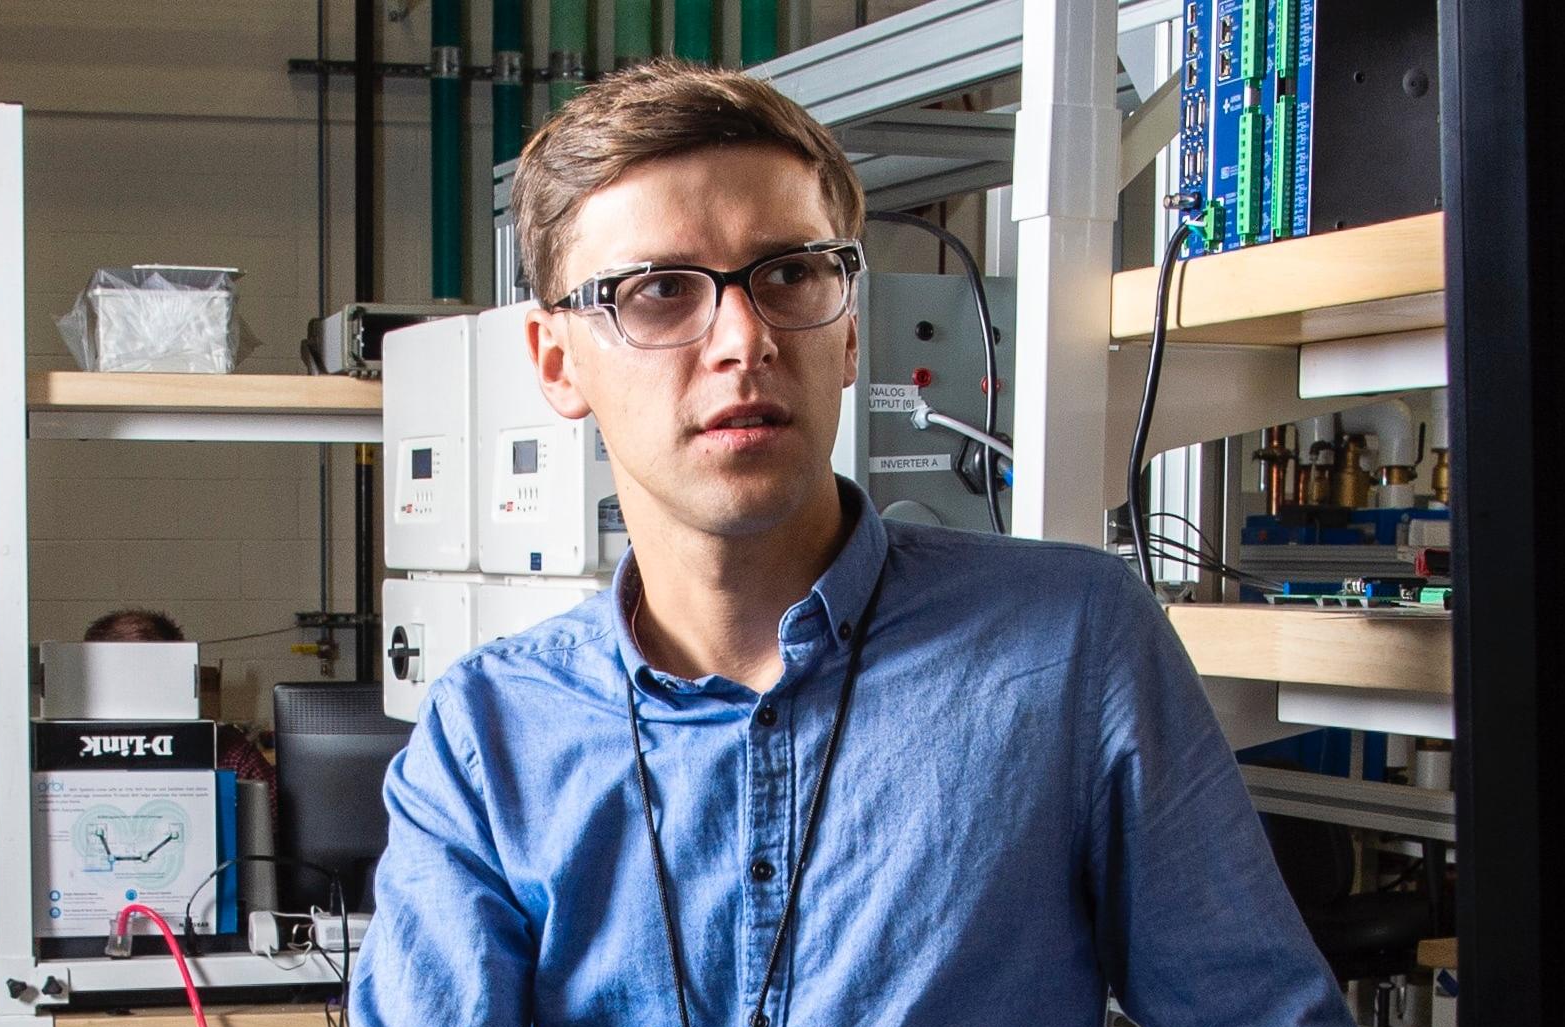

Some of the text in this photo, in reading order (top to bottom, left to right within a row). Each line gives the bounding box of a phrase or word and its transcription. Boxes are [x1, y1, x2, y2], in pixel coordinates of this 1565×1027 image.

[869, 387, 905, 397] NALOG
[869, 398, 900, 409] UTPUT
[880, 457, 939, 469] INVERTER A
[80, 735, 174, 757] D-Link
